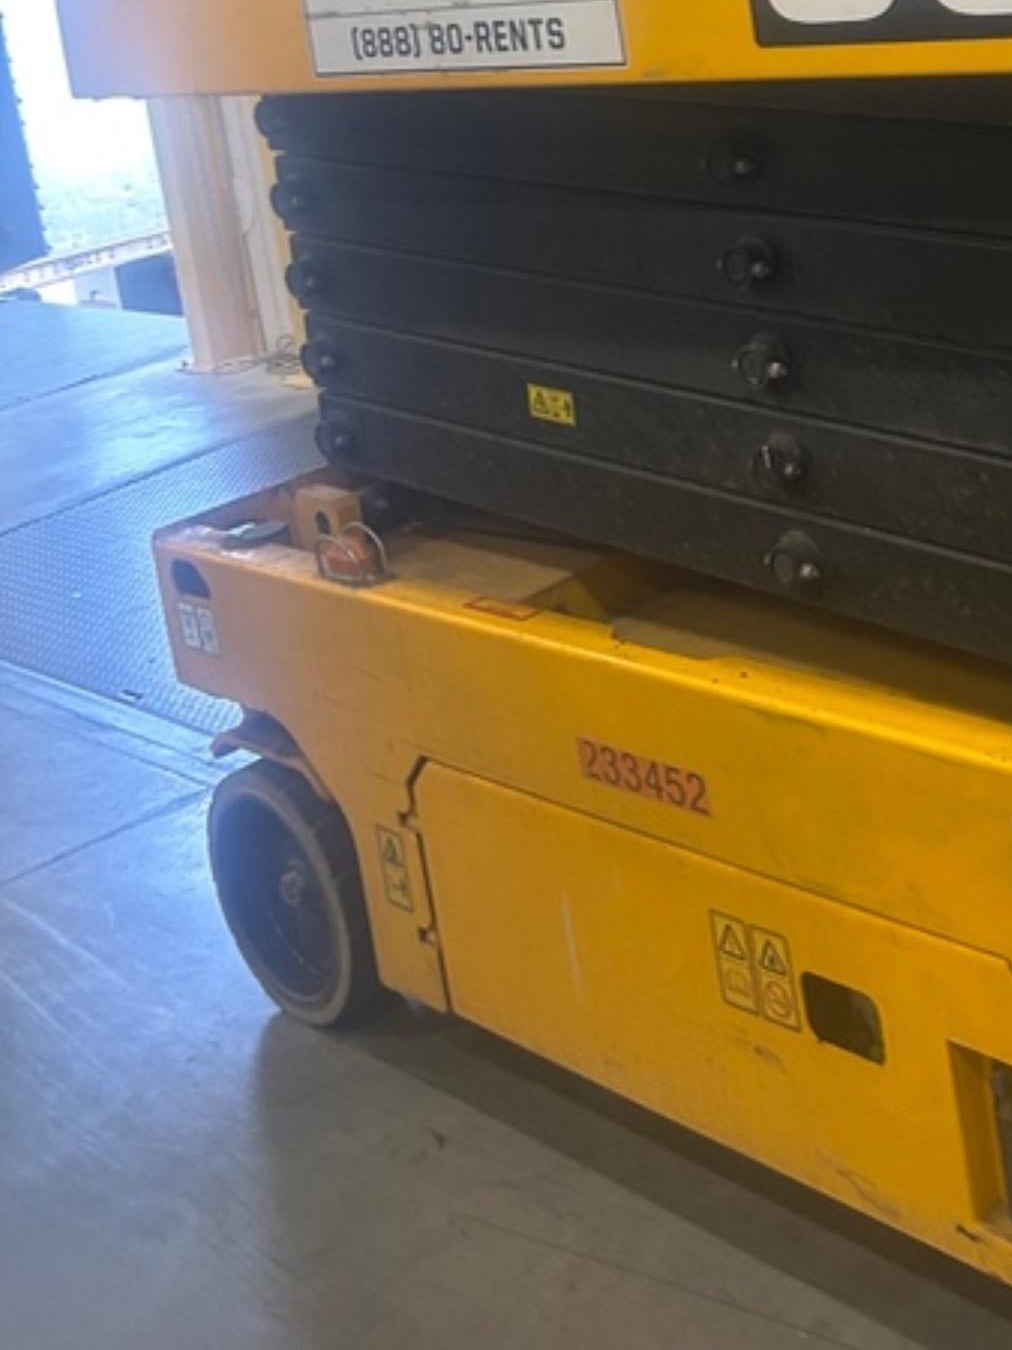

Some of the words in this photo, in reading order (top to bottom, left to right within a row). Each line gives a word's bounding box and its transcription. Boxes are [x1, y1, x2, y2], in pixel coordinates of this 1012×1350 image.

[351, 24, 421, 61] (888)
[430, 17, 566, 56] 80-RENTS
[578, 738, 712, 817] 233452
